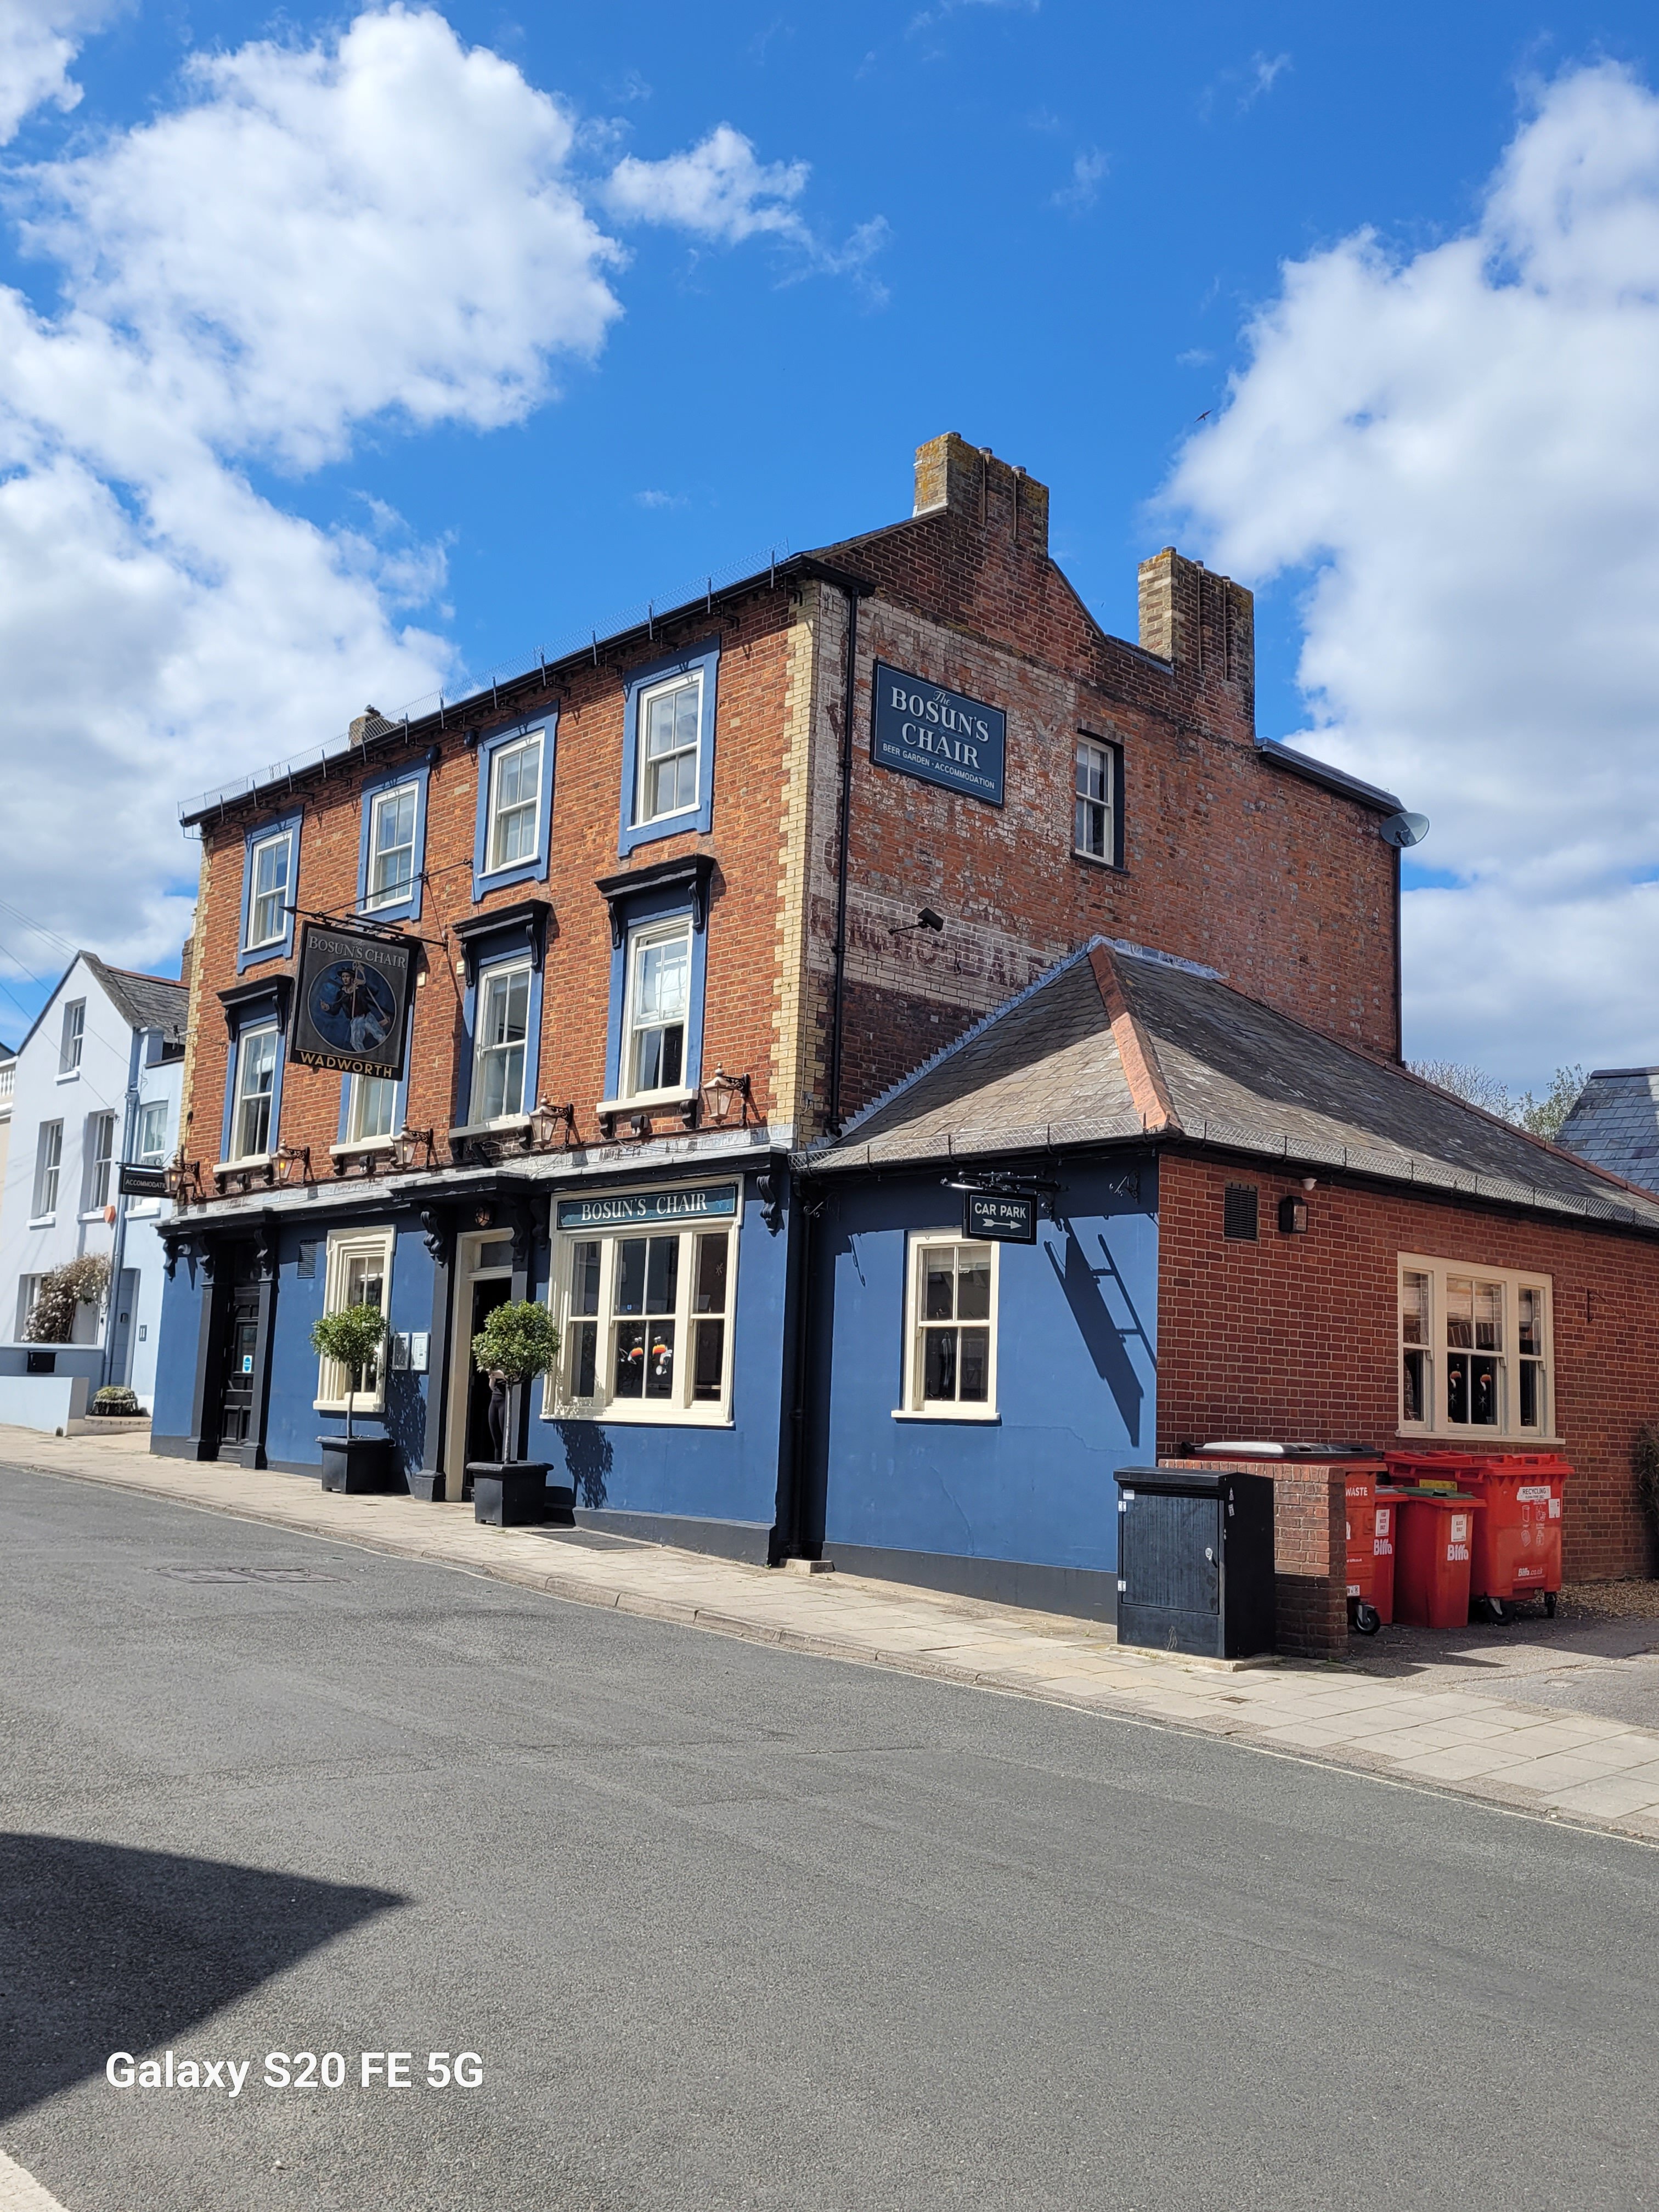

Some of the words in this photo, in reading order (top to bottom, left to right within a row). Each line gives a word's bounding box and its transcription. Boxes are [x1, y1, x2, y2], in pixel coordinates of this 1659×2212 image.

[933, 691, 952, 706] The
[890, 686, 989, 742] BOSUN'S
[902, 723, 980, 769] CHAIR
[883, 743, 900, 757] BEER
[902, 751, 930, 766] GARDEN
[935, 762, 995, 789] ACCOMMODATION
[308, 936, 363, 959] BOSUN'S
[365, 949, 406, 969] CHAIR
[301, 1052, 392, 1078] WADWORTH
[125, 1179, 166, 1189] ACCOMMODATI
[581, 1198, 646, 1221] BOSUN'S
[656, 1193, 708, 1215] CHAIR
[974, 1202, 996, 1216] CAR
[1000, 1205, 1026, 1218] PARK
[1345, 1487, 1368, 1497] WASTE
[1374, 1538, 1393, 1555] Biffa
[1447, 1544, 1469, 1561] Biffa
